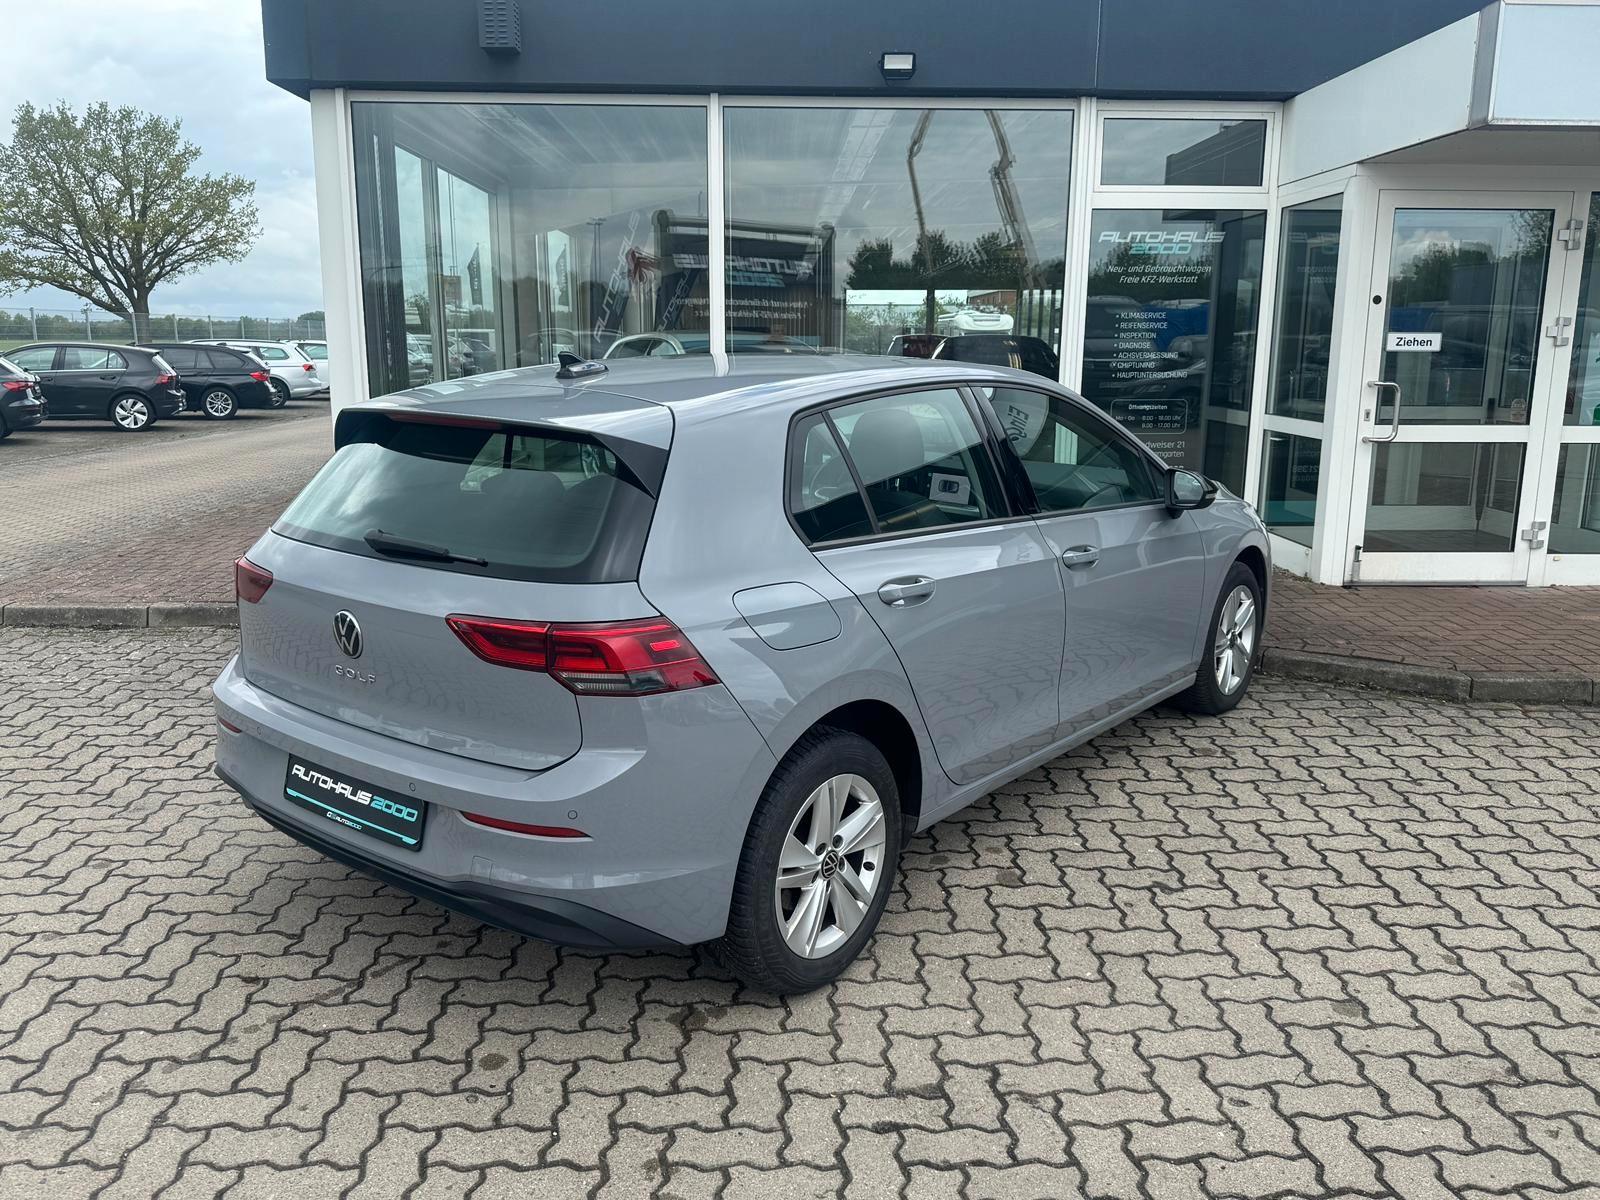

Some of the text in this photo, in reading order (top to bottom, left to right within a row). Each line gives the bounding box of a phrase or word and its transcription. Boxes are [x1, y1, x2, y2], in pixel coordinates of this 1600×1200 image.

[1098, 231, 1226, 243] AUTOHAUS
[1129, 243, 1192, 255] 2000
[1107, 264, 1212, 274] Neu- und Gebrauchtwagen
[1119, 275, 1199, 284] Freie KFZ-Werkstatt
[1120, 311, 1167, 319] KLIMASERVICE
[1119, 321, 1168, 329] REIFENSERVICE
[1395, 336, 1433, 347] Ziehen
[1117, 361, 1156, 369] CHIPTUNING
[1116, 371, 1188, 379] HAUPTUNTERSUCHUNG
[1176, 440, 1186, 448] 21
[335, 664, 376, 684] GOLF
[291, 763, 419, 823] AUTOHAUS 2000
